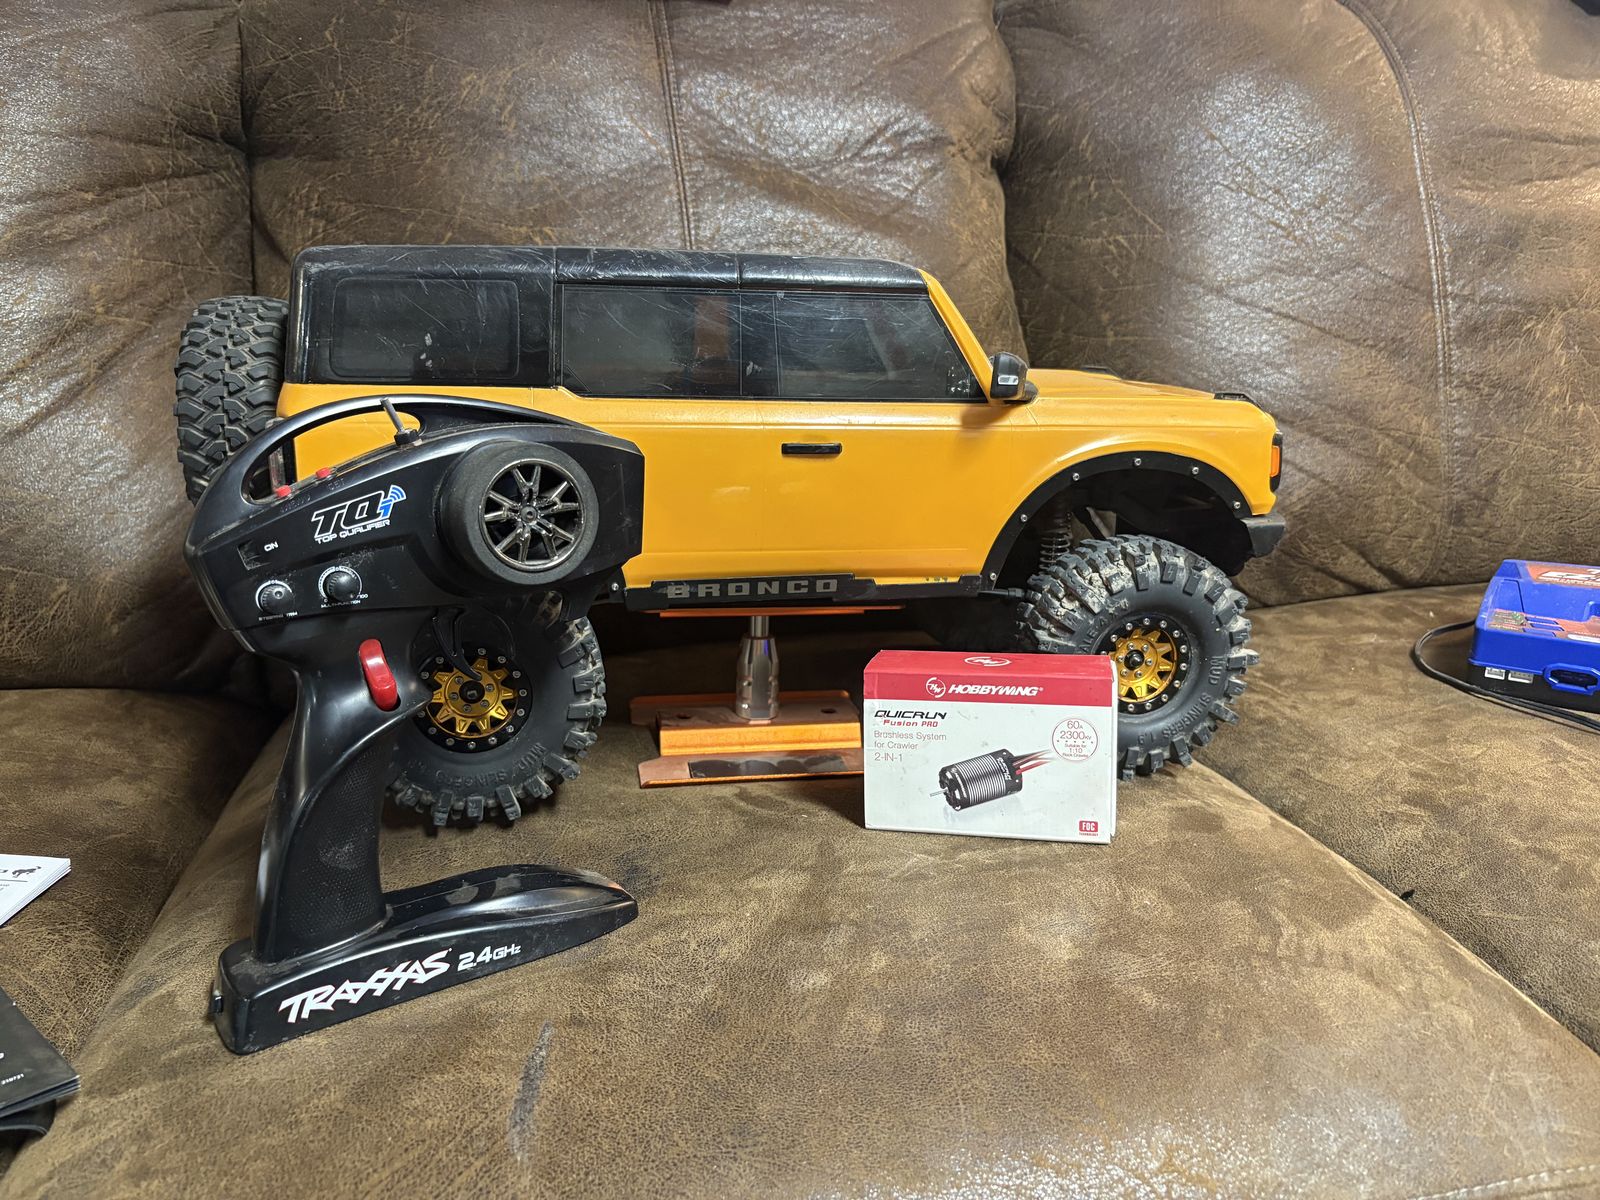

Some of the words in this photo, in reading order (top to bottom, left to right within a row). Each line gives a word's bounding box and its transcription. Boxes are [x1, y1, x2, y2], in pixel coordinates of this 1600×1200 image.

[315, 534, 337, 544] TOP
[339, 519, 390, 538] QUALIFIER
[264, 541, 279, 552] ON
[667, 579, 838, 598] BRONCO
[948, 684, 1039, 696] HOBBYWING
[874, 710, 947, 720] QUICRUN
[883, 719, 918, 727] Fusion
[921, 720, 939, 728] PRO
[874, 730, 914, 740] Brushless
[916, 731, 947, 742] System
[887, 741, 919, 750] Crawler
[874, 752, 903, 762] 2-IN-1
[1082, 822, 1096, 831] FOC
[278, 949, 451, 1024] TRAXXAS
